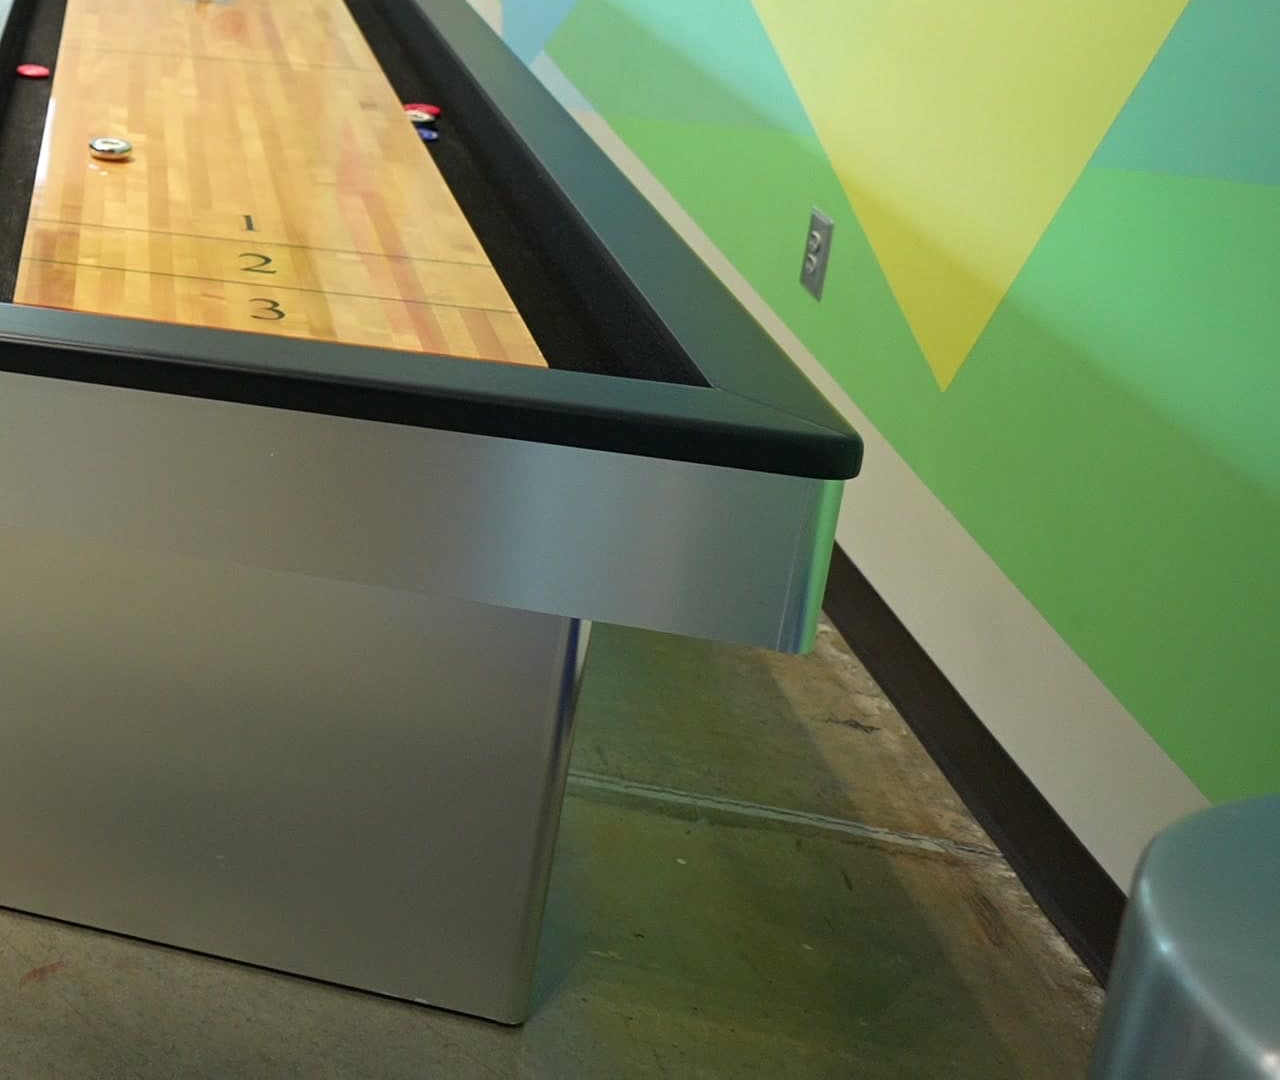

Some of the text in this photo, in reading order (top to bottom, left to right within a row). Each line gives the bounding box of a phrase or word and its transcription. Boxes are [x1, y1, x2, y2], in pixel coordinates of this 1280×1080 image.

[241, 214, 257, 233] 1
[238, 252, 278, 275] 2
[248, 297, 286, 321] 3
